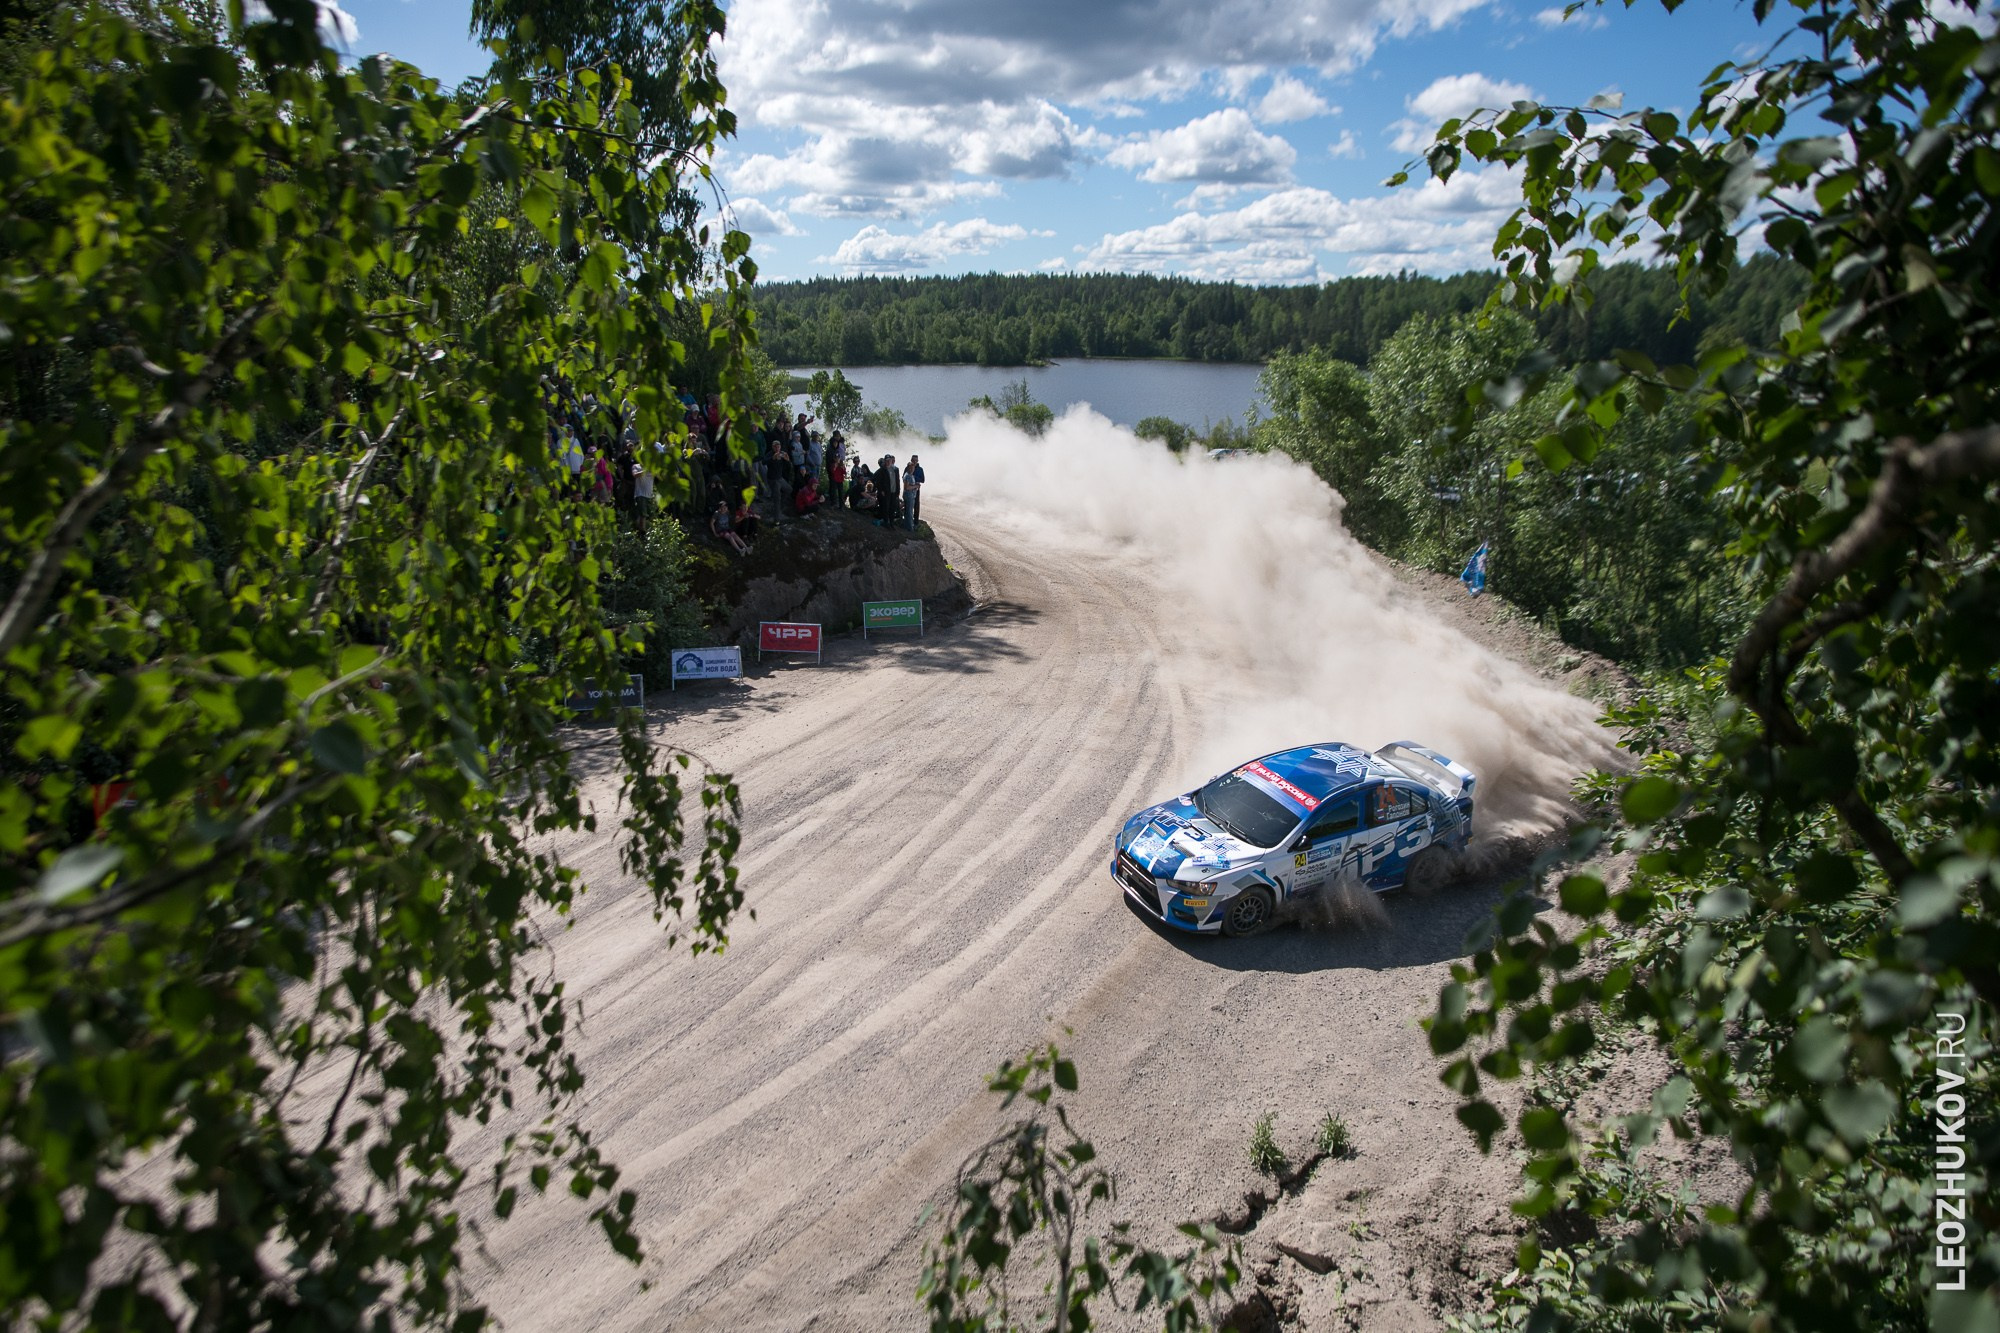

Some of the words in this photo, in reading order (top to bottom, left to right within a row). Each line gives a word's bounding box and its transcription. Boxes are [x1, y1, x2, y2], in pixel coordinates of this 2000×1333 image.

[768, 627, 812, 639] ЧРР
[1256, 767, 1280, 784] РАЛЛИ
[1278, 780, 1307, 801] РОССИИ
[1376, 784, 1397, 809] 24
[1294, 853, 1307, 868] 24
